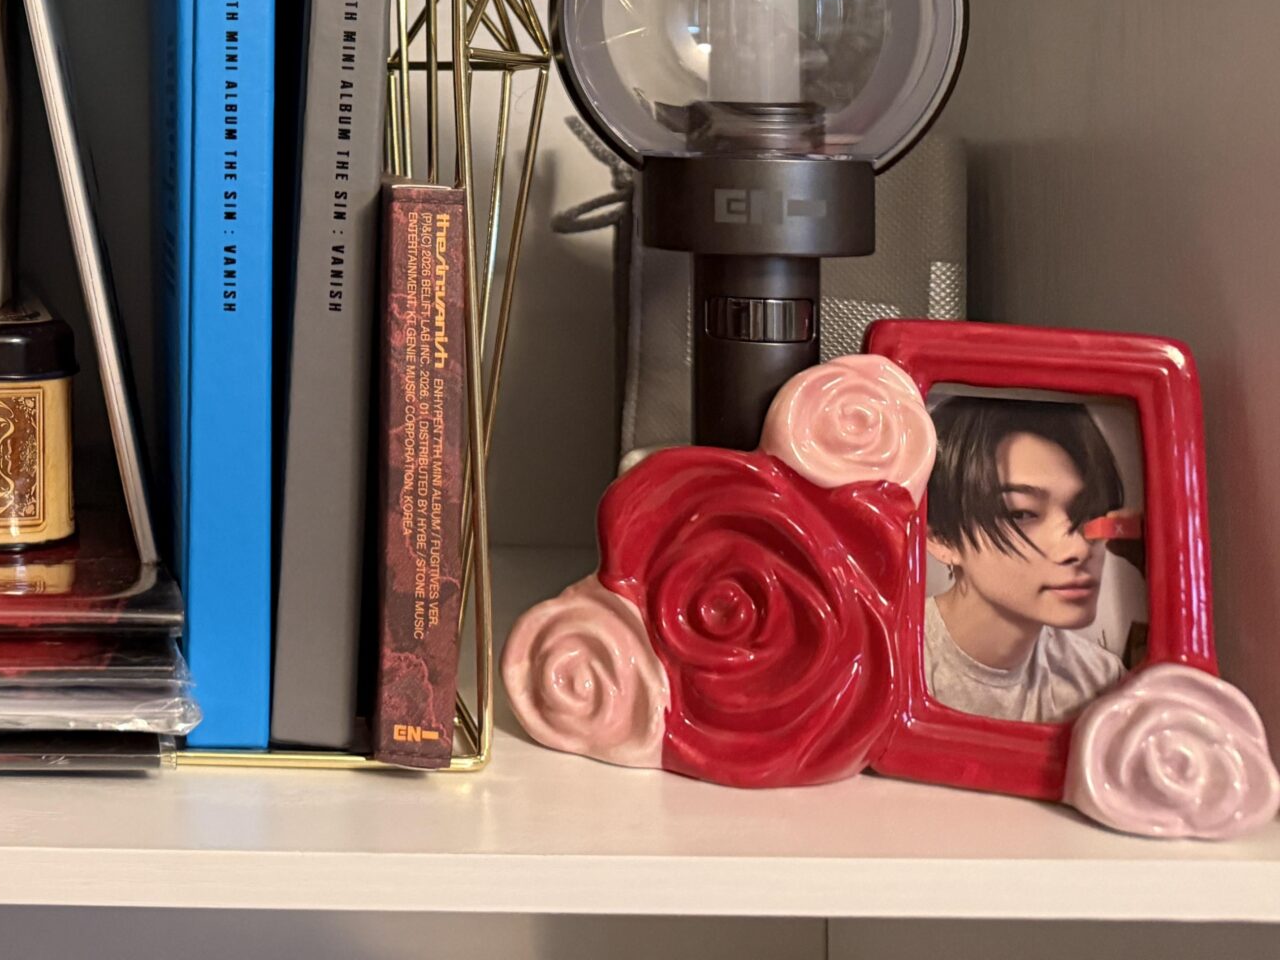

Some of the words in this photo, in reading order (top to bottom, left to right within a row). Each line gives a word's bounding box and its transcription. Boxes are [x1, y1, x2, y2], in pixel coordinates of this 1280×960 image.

[225, 31, 238, 70] MINI
[341, 31, 357, 70] MINI
[225, 80, 238, 140] ALBUM
[337, 80, 353, 140] ALBUM
[224, 151, 237, 180] THE
[335, 151, 350, 181] THE
[224, 191, 237, 220] SIN
[333, 191, 348, 220] SIN
[224, 245, 237, 312] VANISH
[328, 245, 345, 312] VANISH
[421, 250, 431, 276] 2026
[420, 279, 431, 318] BELIFT
[406, 310, 416, 326] KT
[420, 319, 430, 341] LAB
[405, 328, 416, 362] GENIE
[420, 344, 430, 367] INC.
[404, 365, 416, 402] MUSIC
[419, 370, 430, 397] 2026.
[432, 378, 444, 434] ENHYPEN
[417, 421, 429, 495] DISTRIBUTED
[432, 436, 444, 458] 7TH
[432, 461, 443, 487] MINI
[402, 495, 413, 535] KOREA
[417, 499, 427, 515] BY
[431, 489, 442, 530] ALBUM
[416, 518, 427, 549] HYBE
[414, 559, 426, 598] STONE
[429, 540, 441, 600] FUGITIVES
[413, 601, 424, 639] MUSIC
[428, 602, 439, 627] VER.
